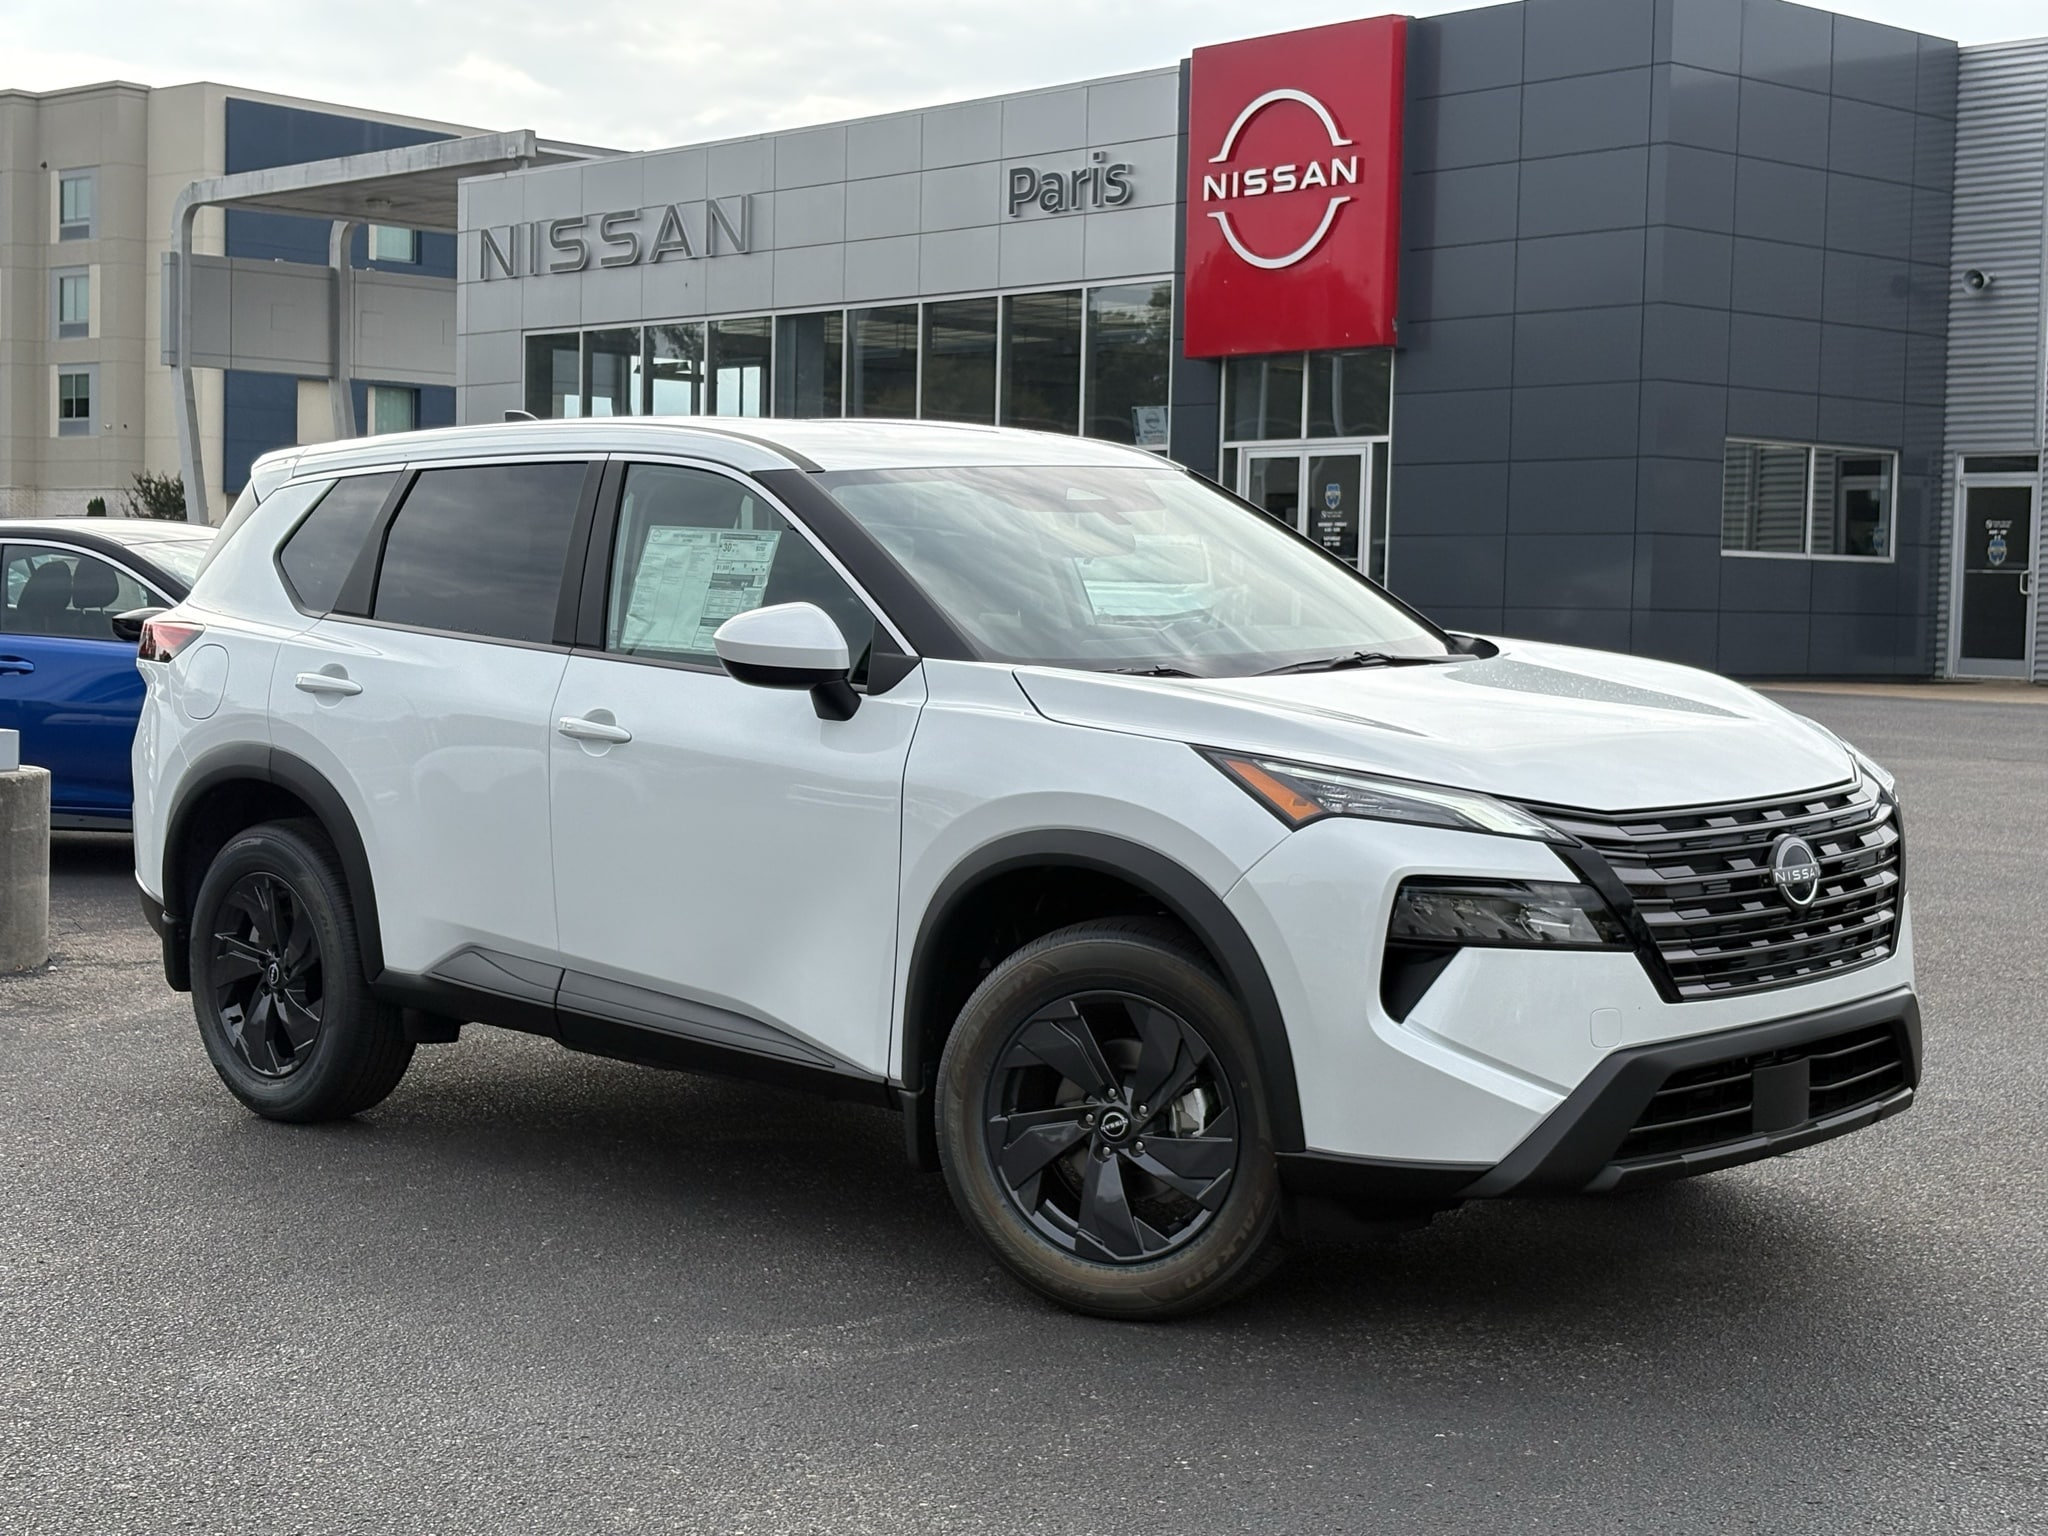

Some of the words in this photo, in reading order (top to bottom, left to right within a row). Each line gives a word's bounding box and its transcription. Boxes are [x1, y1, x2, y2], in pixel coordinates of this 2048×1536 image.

[1008, 151, 1132, 217] Paris
[1203, 155, 1358, 201] NISSAN
[480, 195, 750, 280] NISSAN
[1774, 866, 1820, 883] NISSAN
